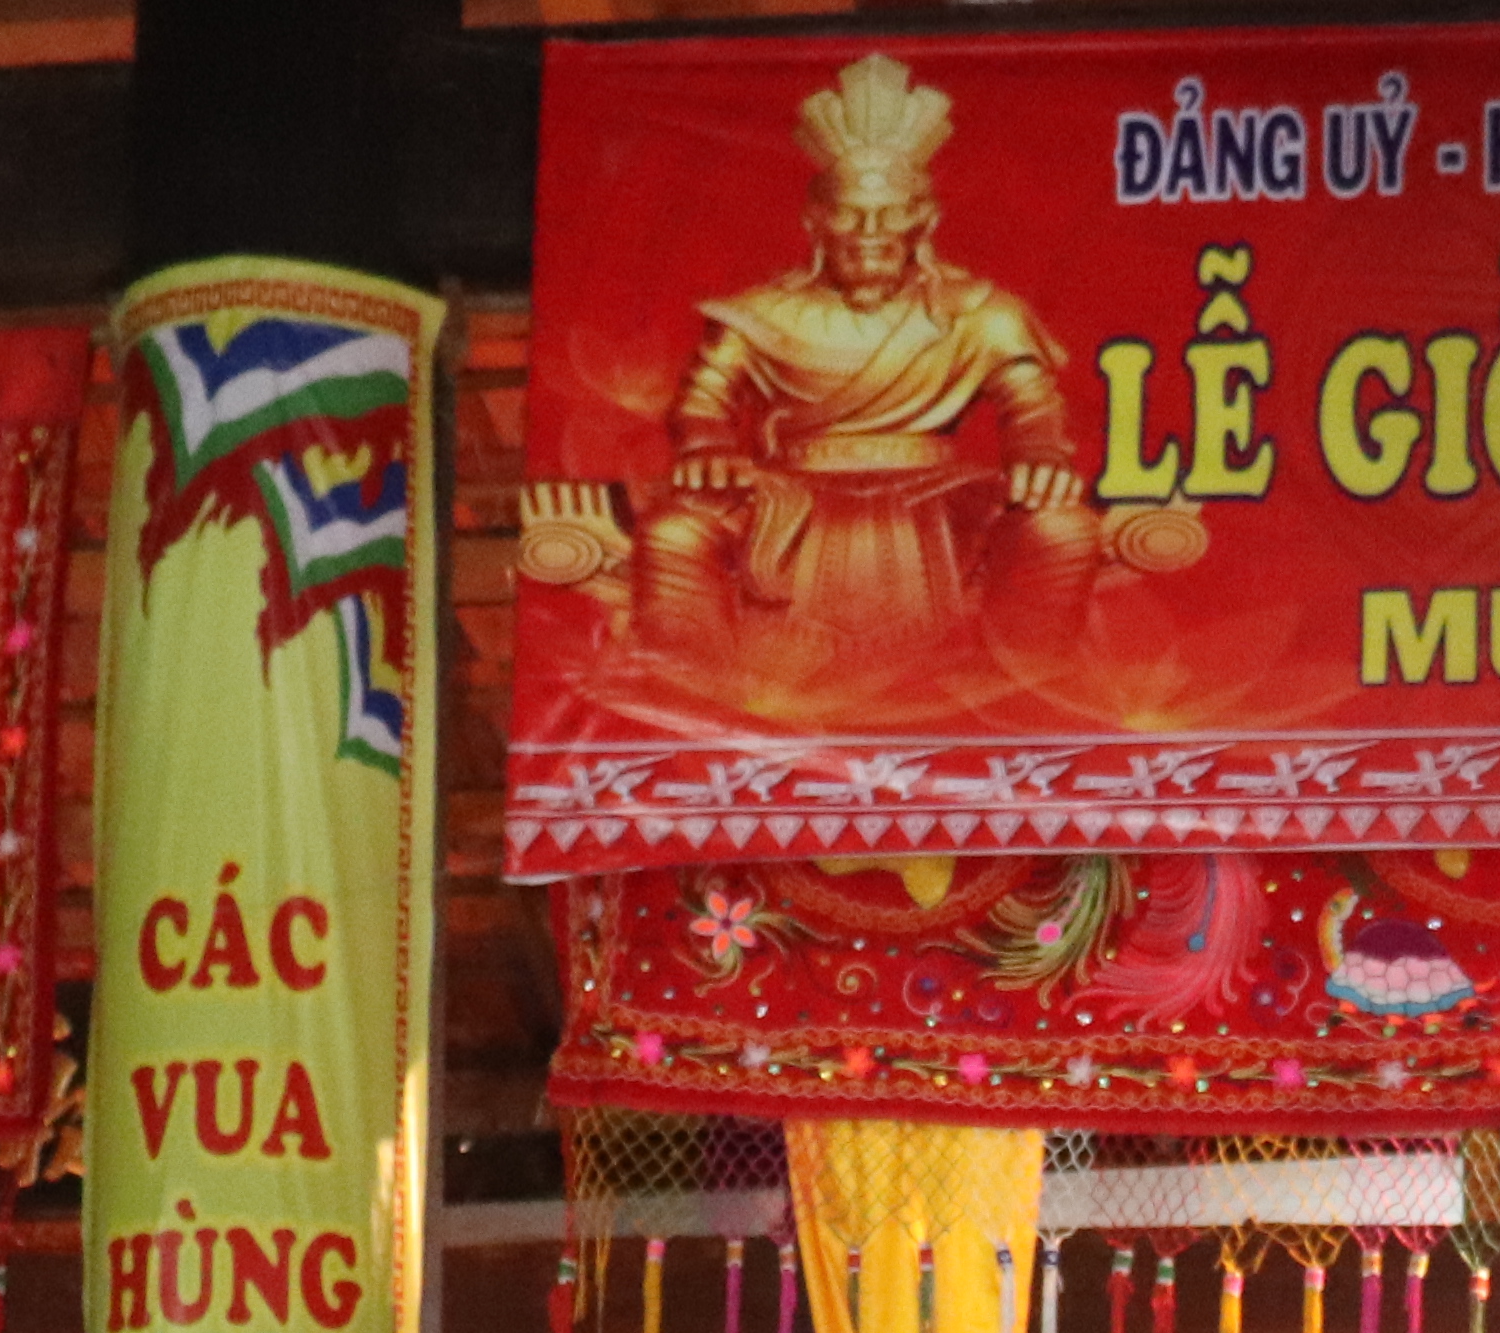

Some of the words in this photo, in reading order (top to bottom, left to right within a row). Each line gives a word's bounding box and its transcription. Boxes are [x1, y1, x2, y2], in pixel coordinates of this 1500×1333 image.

[1114, 75, 1305, 203] ĐẢNG
[1322, 72, 1417, 198] UỶ
[1095, 240, 1278, 504] LỄ
[137, 860, 330, 993] CÁC
[131, 1057, 332, 1161] VUA
[106, 1198, 364, 1333] HÙNG
